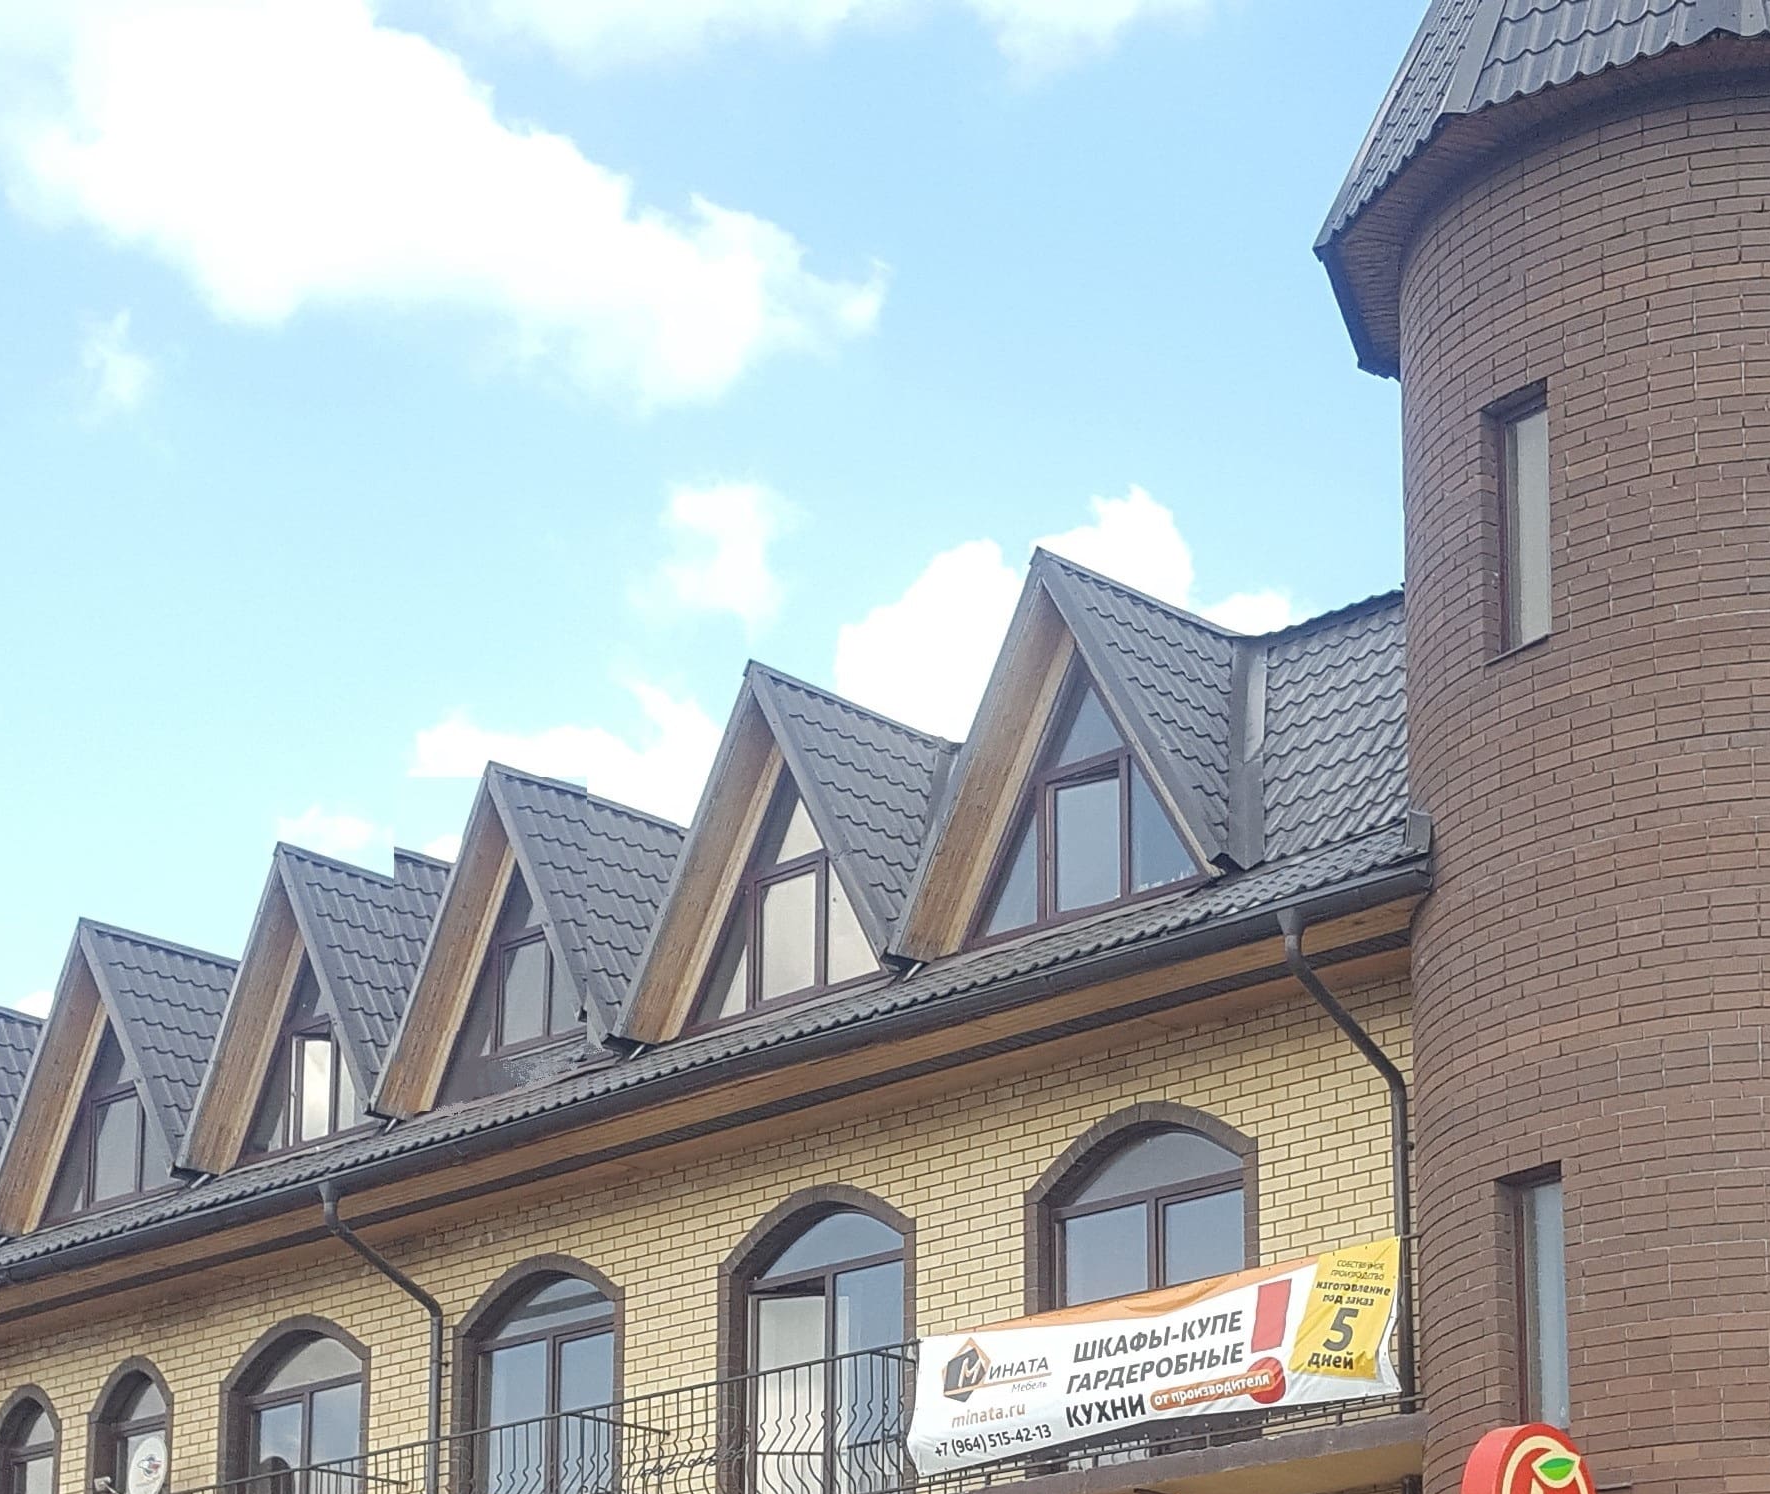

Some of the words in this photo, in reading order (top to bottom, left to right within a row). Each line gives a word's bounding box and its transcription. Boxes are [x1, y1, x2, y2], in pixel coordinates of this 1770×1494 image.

[1073, 1310, 1243, 1363] ШКАФЫ-КУПЕ
[1322, 1307, 1359, 1352] 5
[1066, 1341, 1245, 1395] ГАРДЕРОБНЫЕ
[1307, 1351, 1354, 1370] дней
[951, 1403, 1026, 1428] minata.ru
[1065, 1393, 1146, 1429] КУХНИ
[1154, 1393, 1170, 1406] от
[1172, 1372, 1270, 1405] производителя
[935, 1442, 948, 1457] +7
[951, 1433, 987, 1457] (964)
[989, 1424, 1052, 1448] 515-42-13
